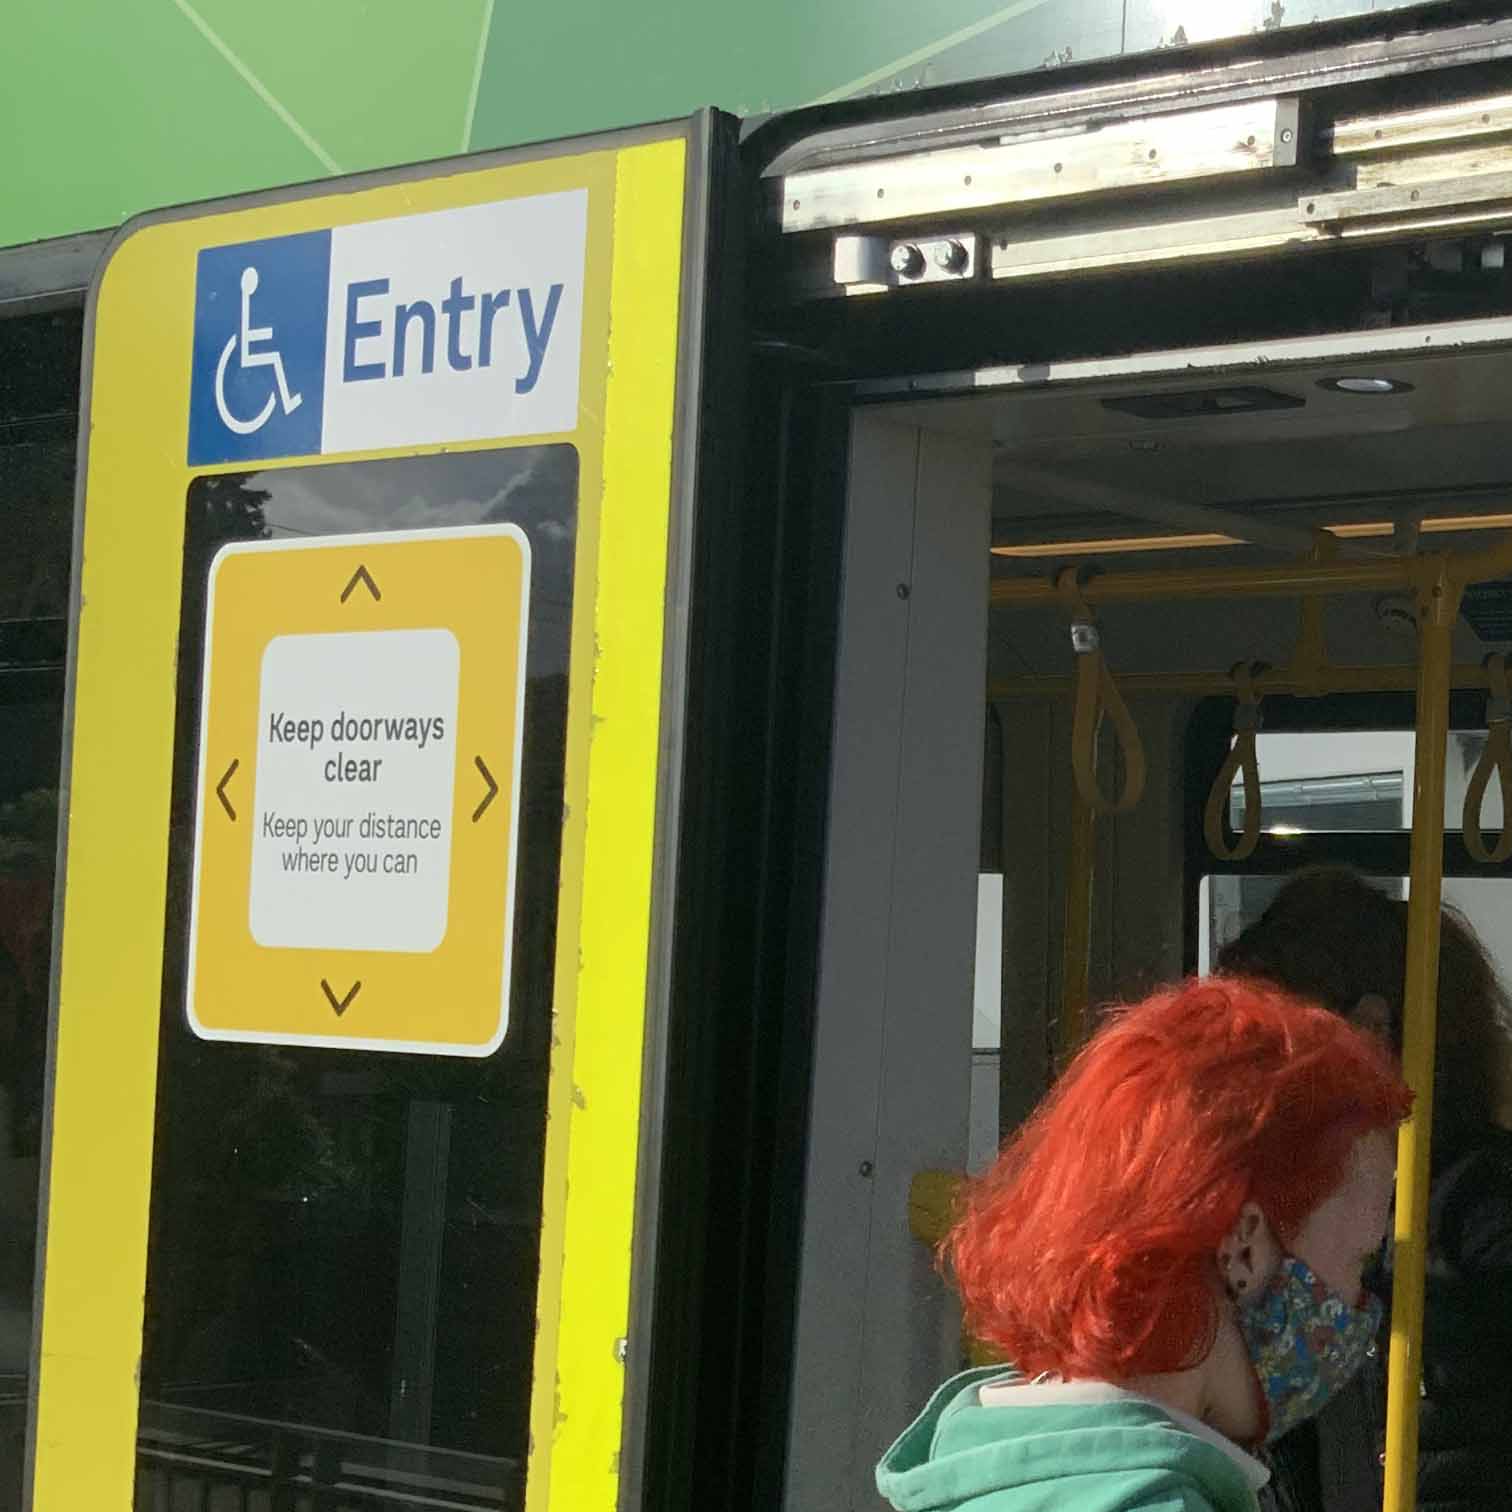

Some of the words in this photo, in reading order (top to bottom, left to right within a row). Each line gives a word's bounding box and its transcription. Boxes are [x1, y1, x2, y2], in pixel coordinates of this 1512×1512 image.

[342, 275, 565, 395] Entry
[268, 712, 324, 750] Keep
[330, 711, 445, 749] doorways
[323, 751, 383, 782] clear
[262, 811, 308, 845] Keep
[312, 817, 353, 845] your
[359, 813, 442, 840] distance
[281, 846, 338, 873] where
[344, 855, 378, 881] you
[382, 853, 419, 874] can
